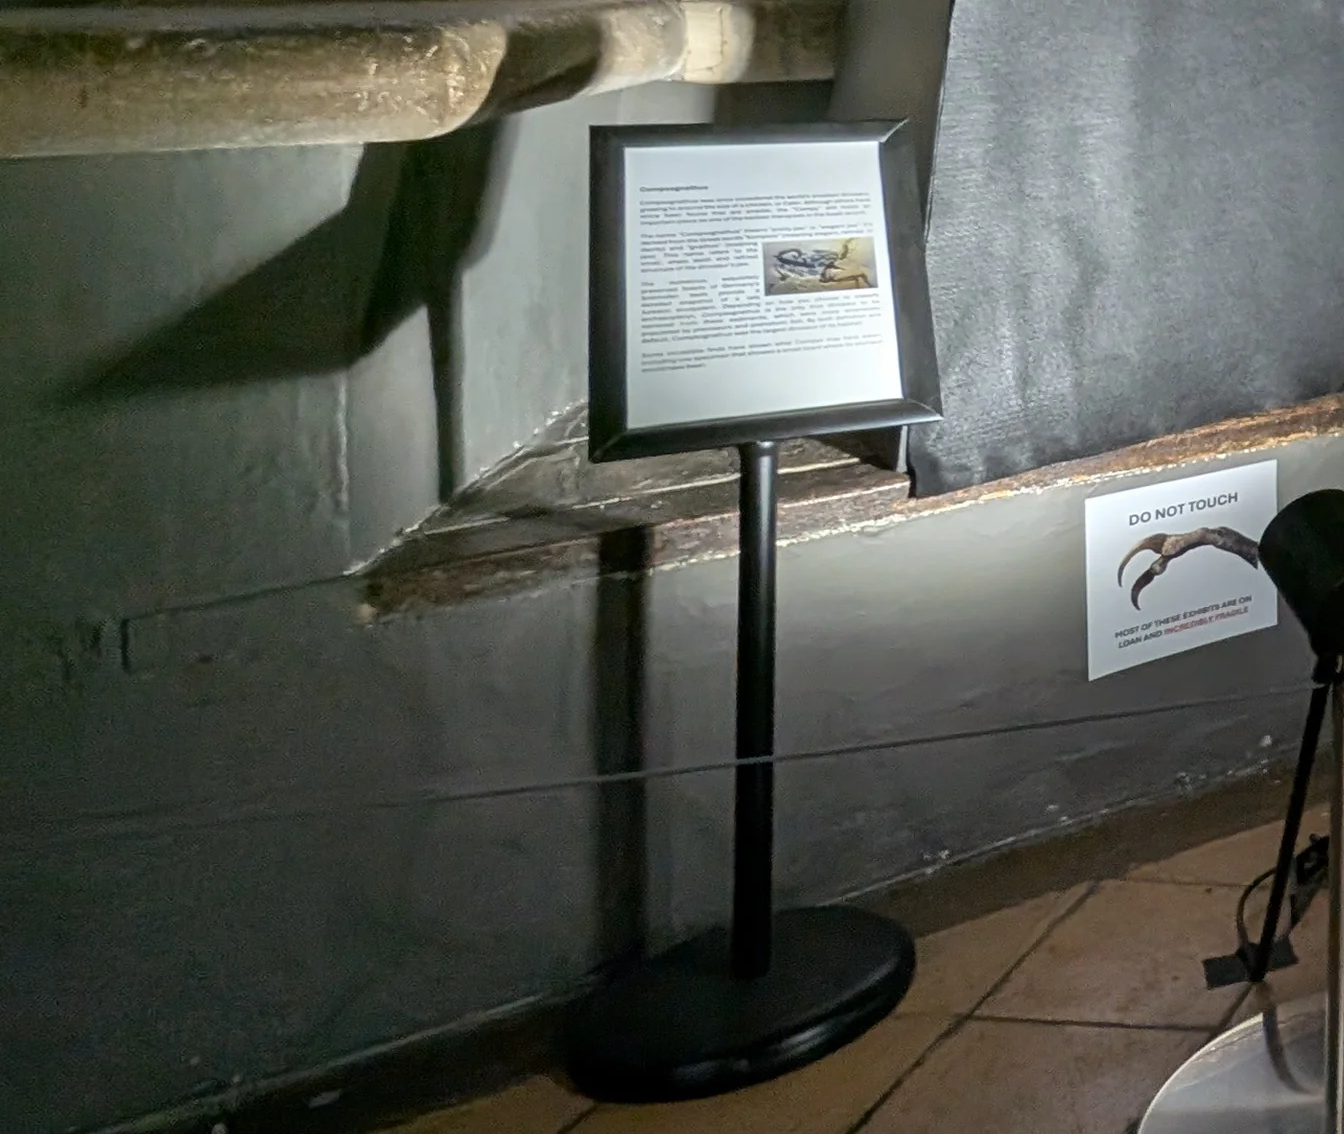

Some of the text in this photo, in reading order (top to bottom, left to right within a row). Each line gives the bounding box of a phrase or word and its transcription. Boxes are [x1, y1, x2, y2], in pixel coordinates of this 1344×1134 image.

[1129, 492, 1239, 526] DO NOT TOUCH
[1114, 595, 1253, 638] MOST OF THESE EXHIBITS ARE ON
[1118, 637, 1142, 649] LOAN
[1144, 630, 1163, 641] AND
